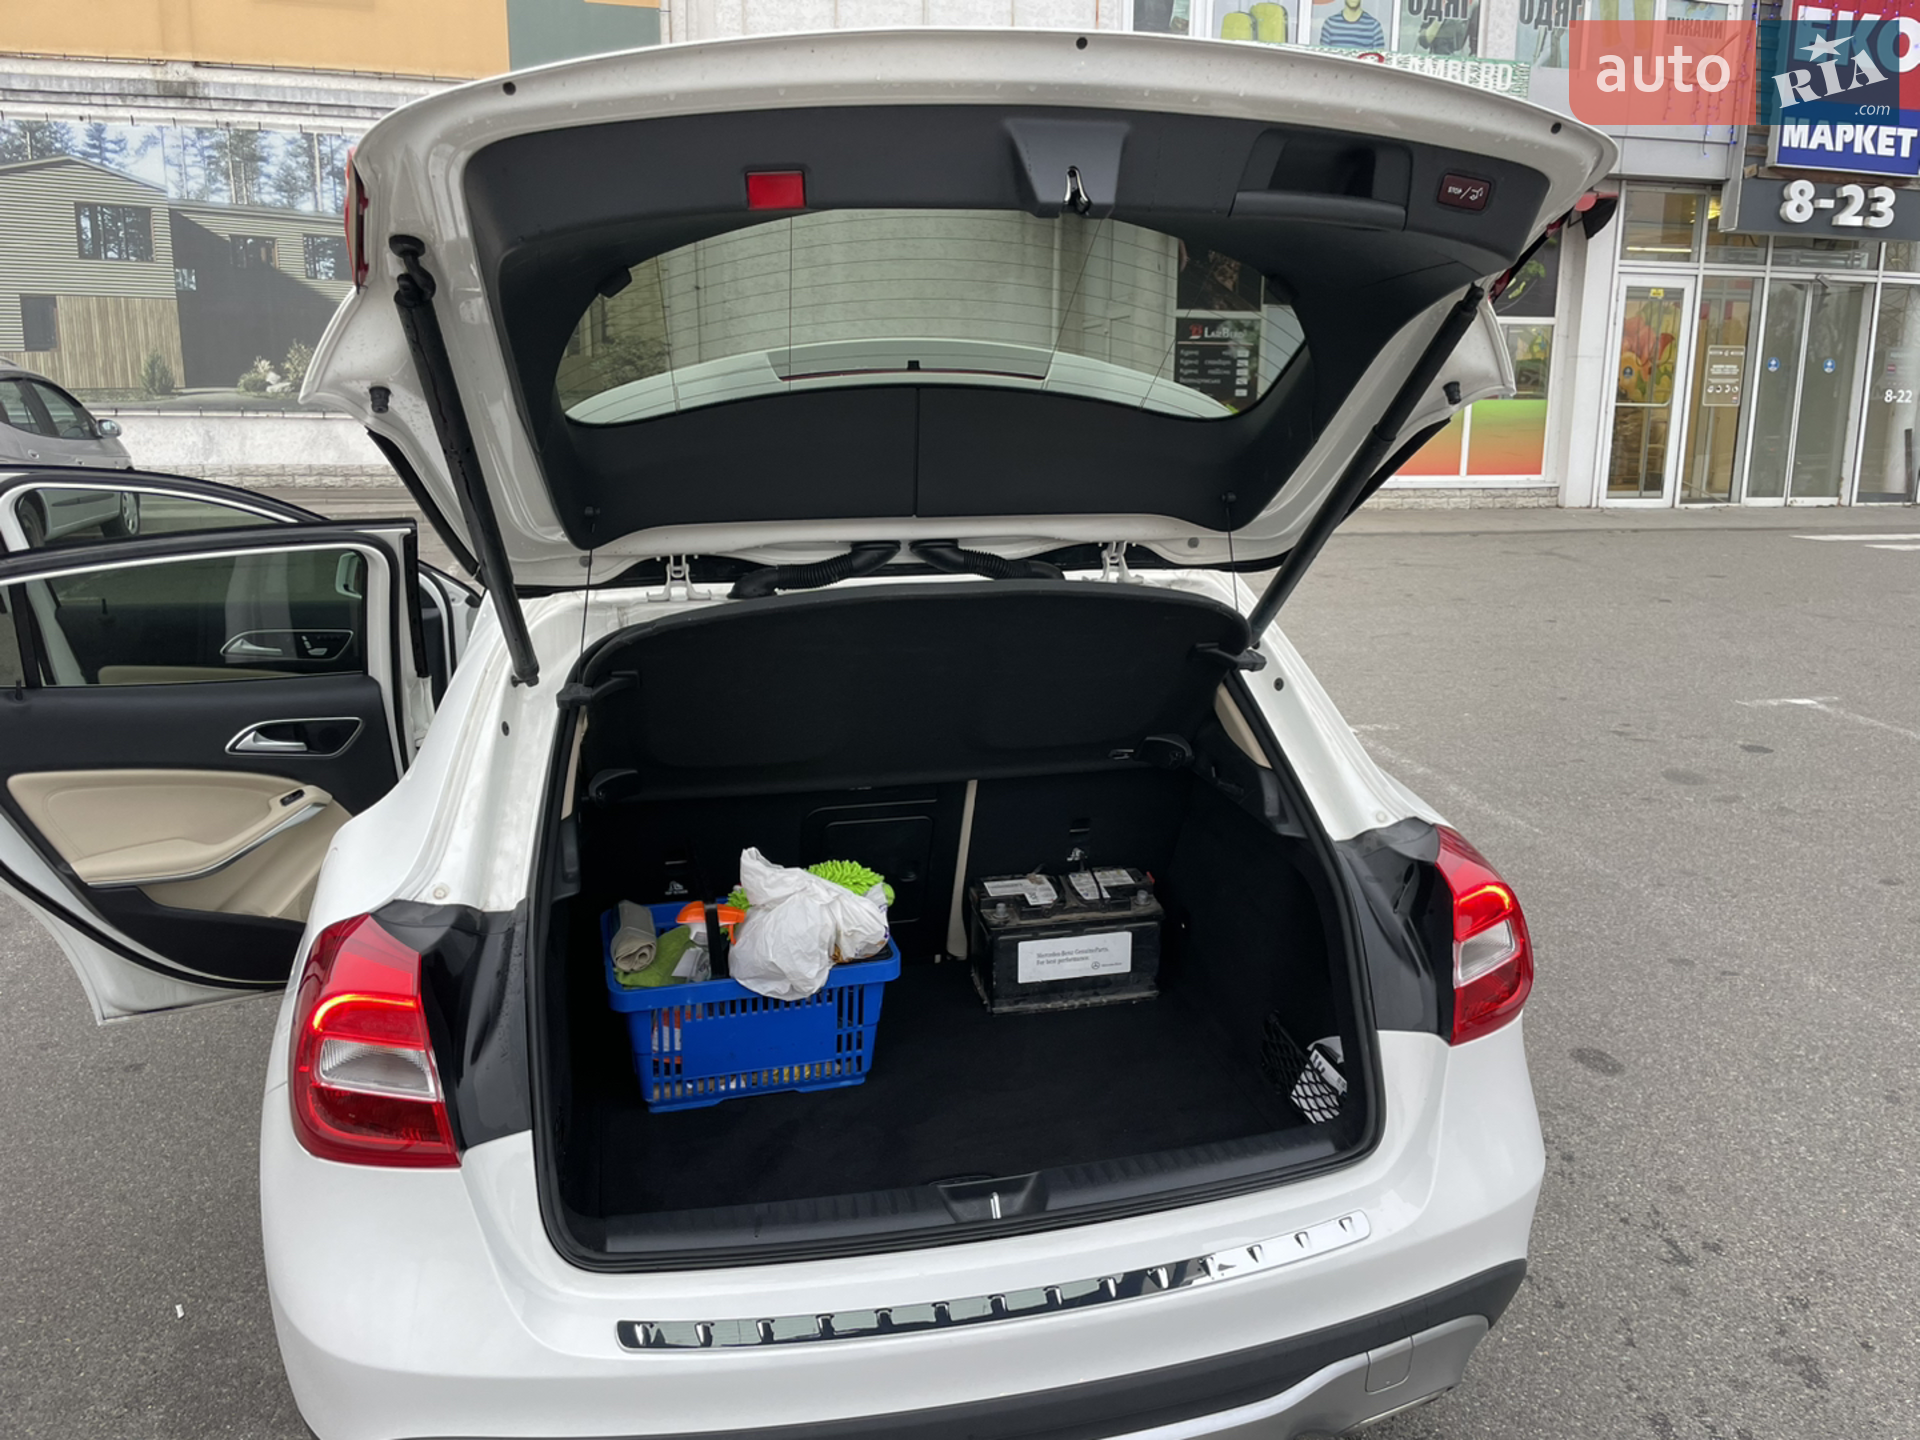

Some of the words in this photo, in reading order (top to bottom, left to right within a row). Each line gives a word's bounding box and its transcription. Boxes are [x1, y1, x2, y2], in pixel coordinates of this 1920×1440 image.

[1793, 5, 1920, 73] ЕКО
[1781, 116, 1918, 158] МАРКЕТ
[1780, 179, 1896, 228] 8-23
[1884, 388, 1913, 403] 8-22
